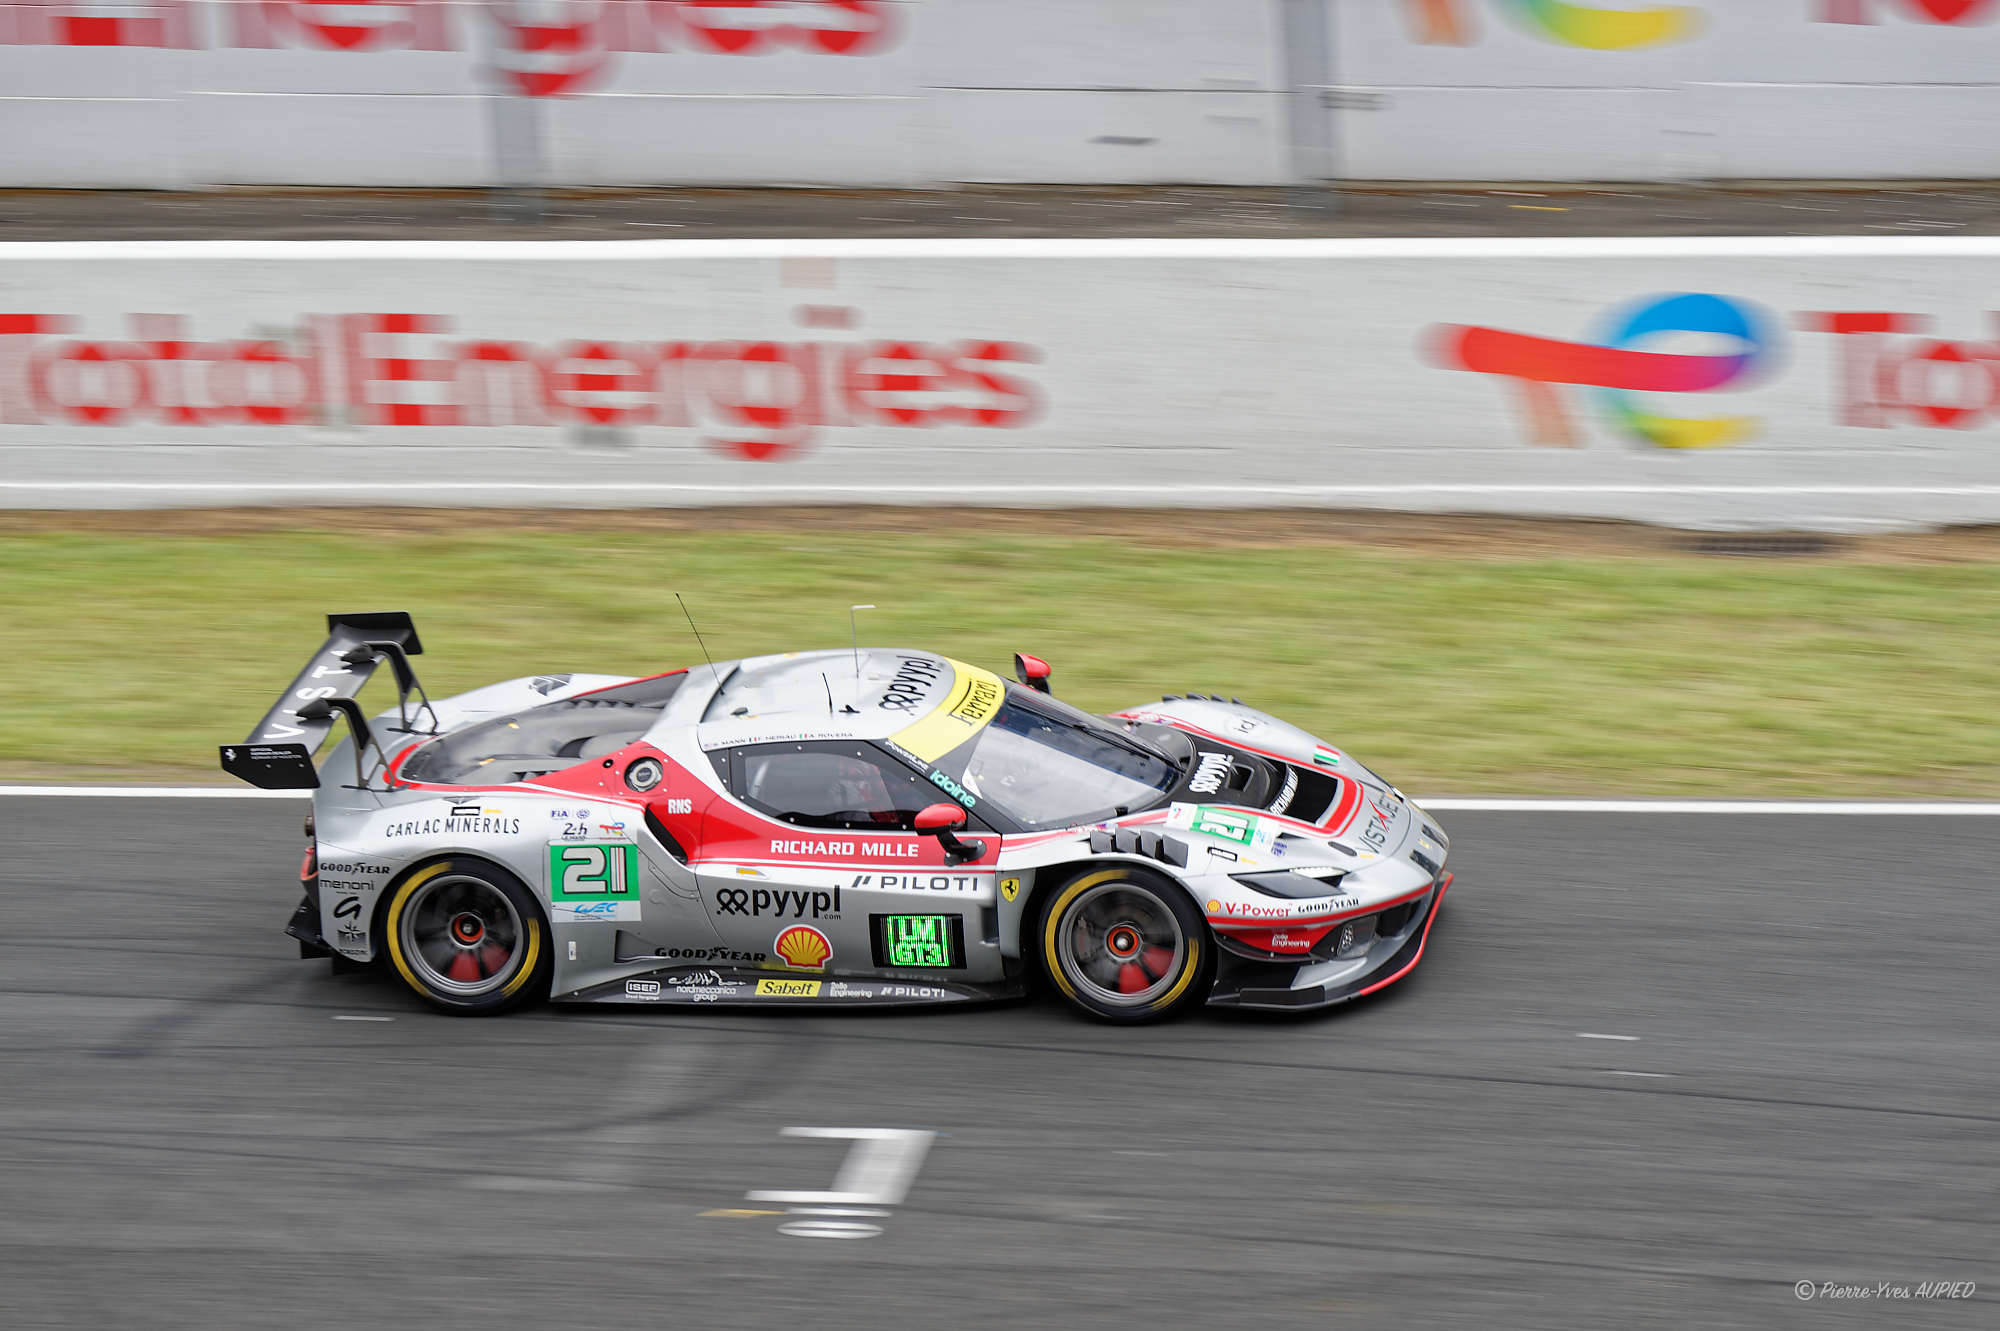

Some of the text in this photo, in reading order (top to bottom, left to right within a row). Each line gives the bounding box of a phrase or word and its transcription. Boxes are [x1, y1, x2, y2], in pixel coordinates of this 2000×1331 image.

[1788, 310, 2000, 430] To
[947, 677, 999, 726] Ferrari
[930, 769, 976, 808] idoine
[668, 799, 692, 814] RNS
[386, 817, 520, 838] CARLAC MINERALS
[770, 840, 919, 857] RICHARD MILLE
[320, 862, 391, 876] GOODYEAR
[562, 846, 628, 894] 21
[320, 880, 374, 891] menoni
[880, 876, 978, 892] PILOTI
[575, 902, 618, 913] WEC
[752, 885, 841, 918] pyypl
[1225, 901, 1291, 917] V-Power
[1298, 898, 1360, 912] GOODYEAR
[654, 947, 767, 962] GOODYEAR
[628, 983, 657, 992] ISEF
[676, 984, 736, 995] nordmeccanica
[762, 981, 814, 995] Sabelt
[895, 987, 945, 997] PILOTI
[693, 994, 718, 1002] group
